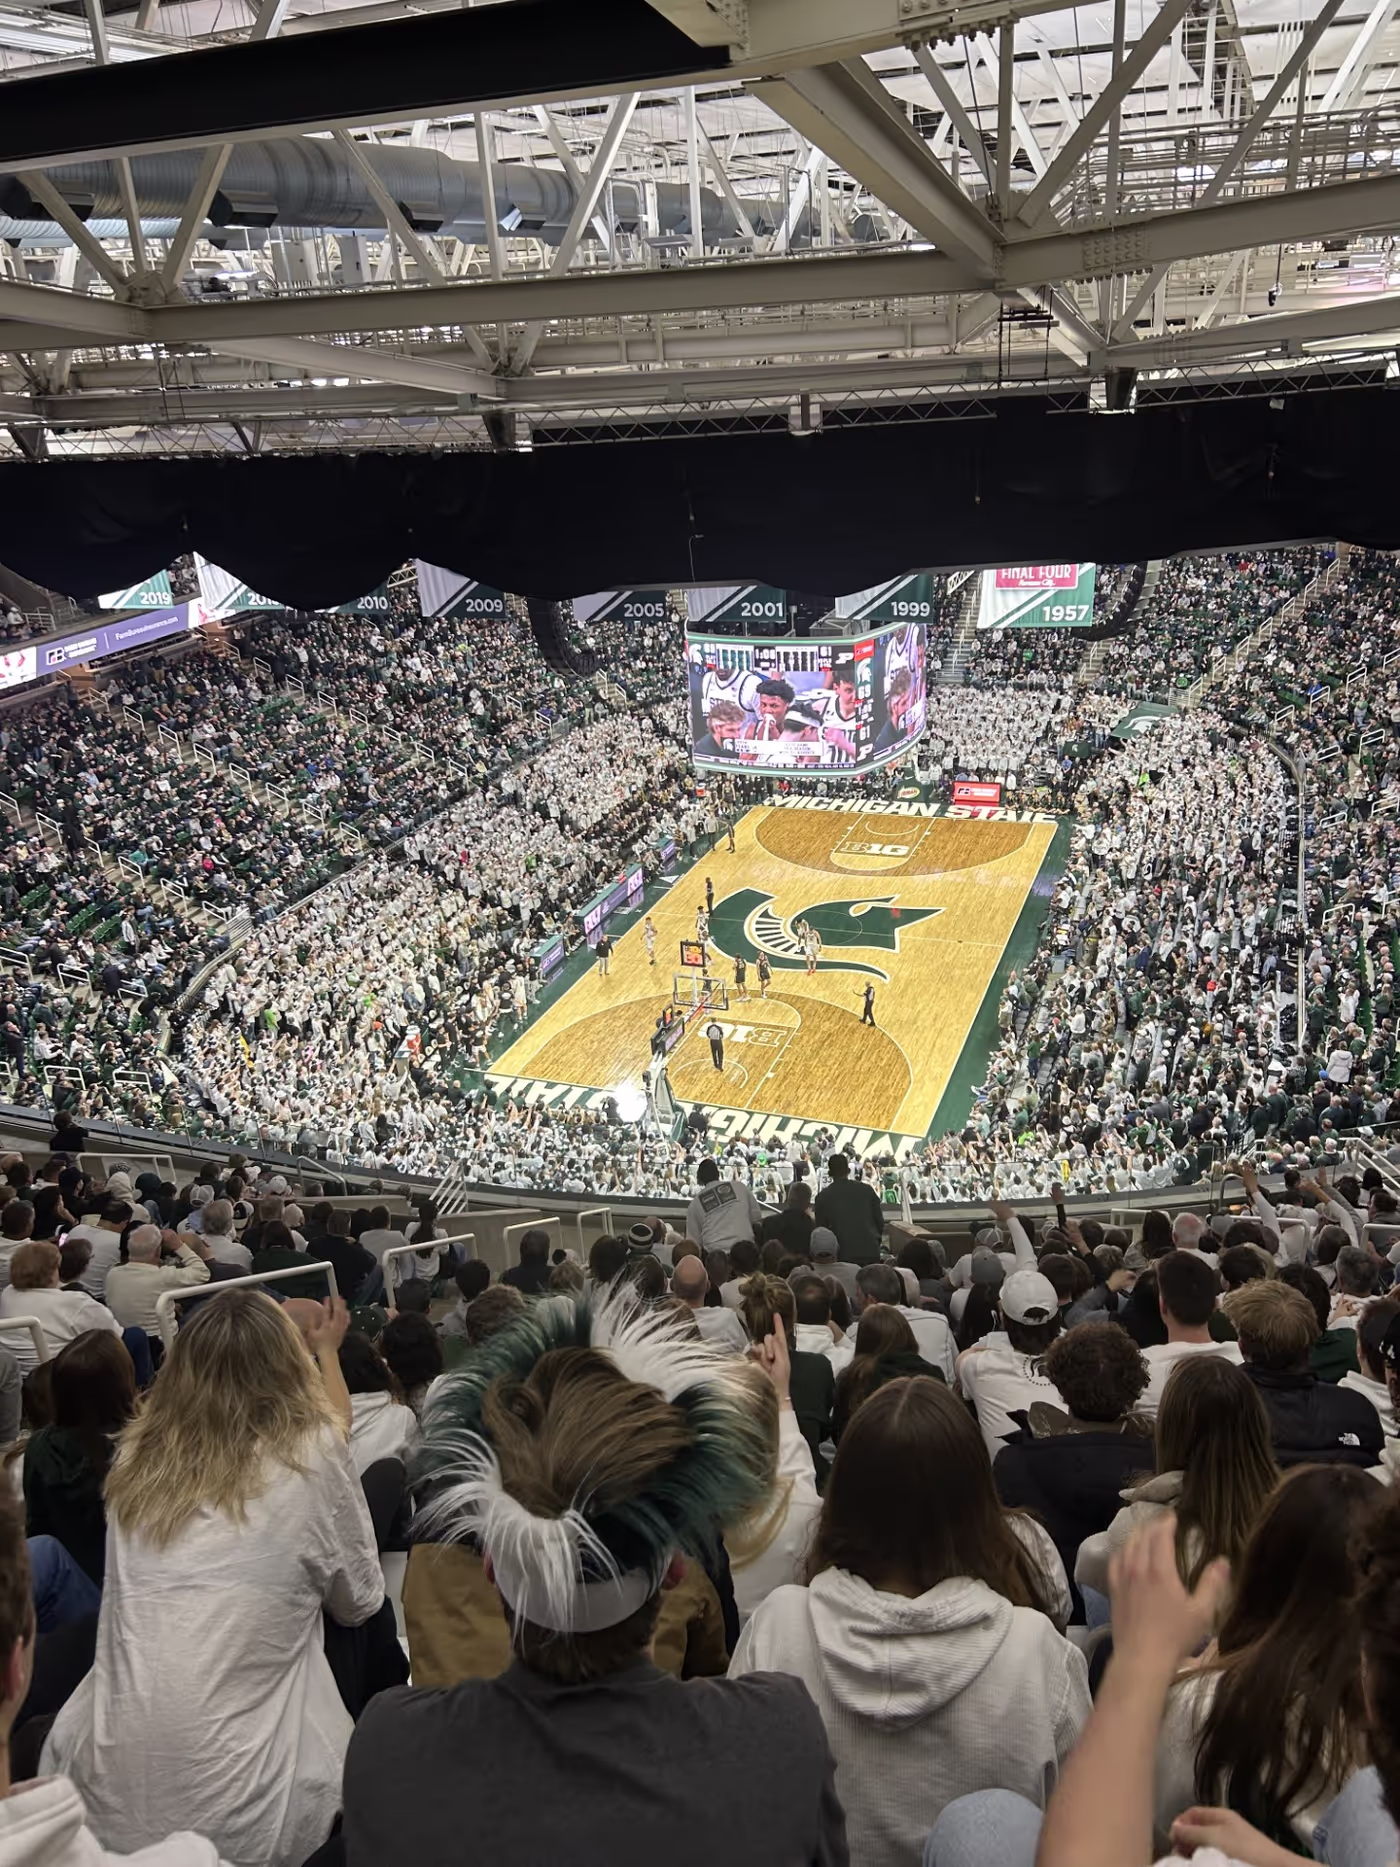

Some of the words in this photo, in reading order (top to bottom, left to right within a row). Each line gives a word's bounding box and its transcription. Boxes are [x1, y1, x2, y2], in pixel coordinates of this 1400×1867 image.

[1001, 568, 1035, 579] FINAL
[1040, 564, 1072, 579] FOUR
[139, 591, 171, 605] 2019
[357, 596, 388, 610] 2010
[465, 599, 503, 613] 2009
[623, 602, 664, 617] 2005
[741, 602, 783, 617] 2001
[891, 601, 931, 617] 1999
[1042, 604, 1090, 621] 1957
[766, 796, 940, 817] MICHIGAN
